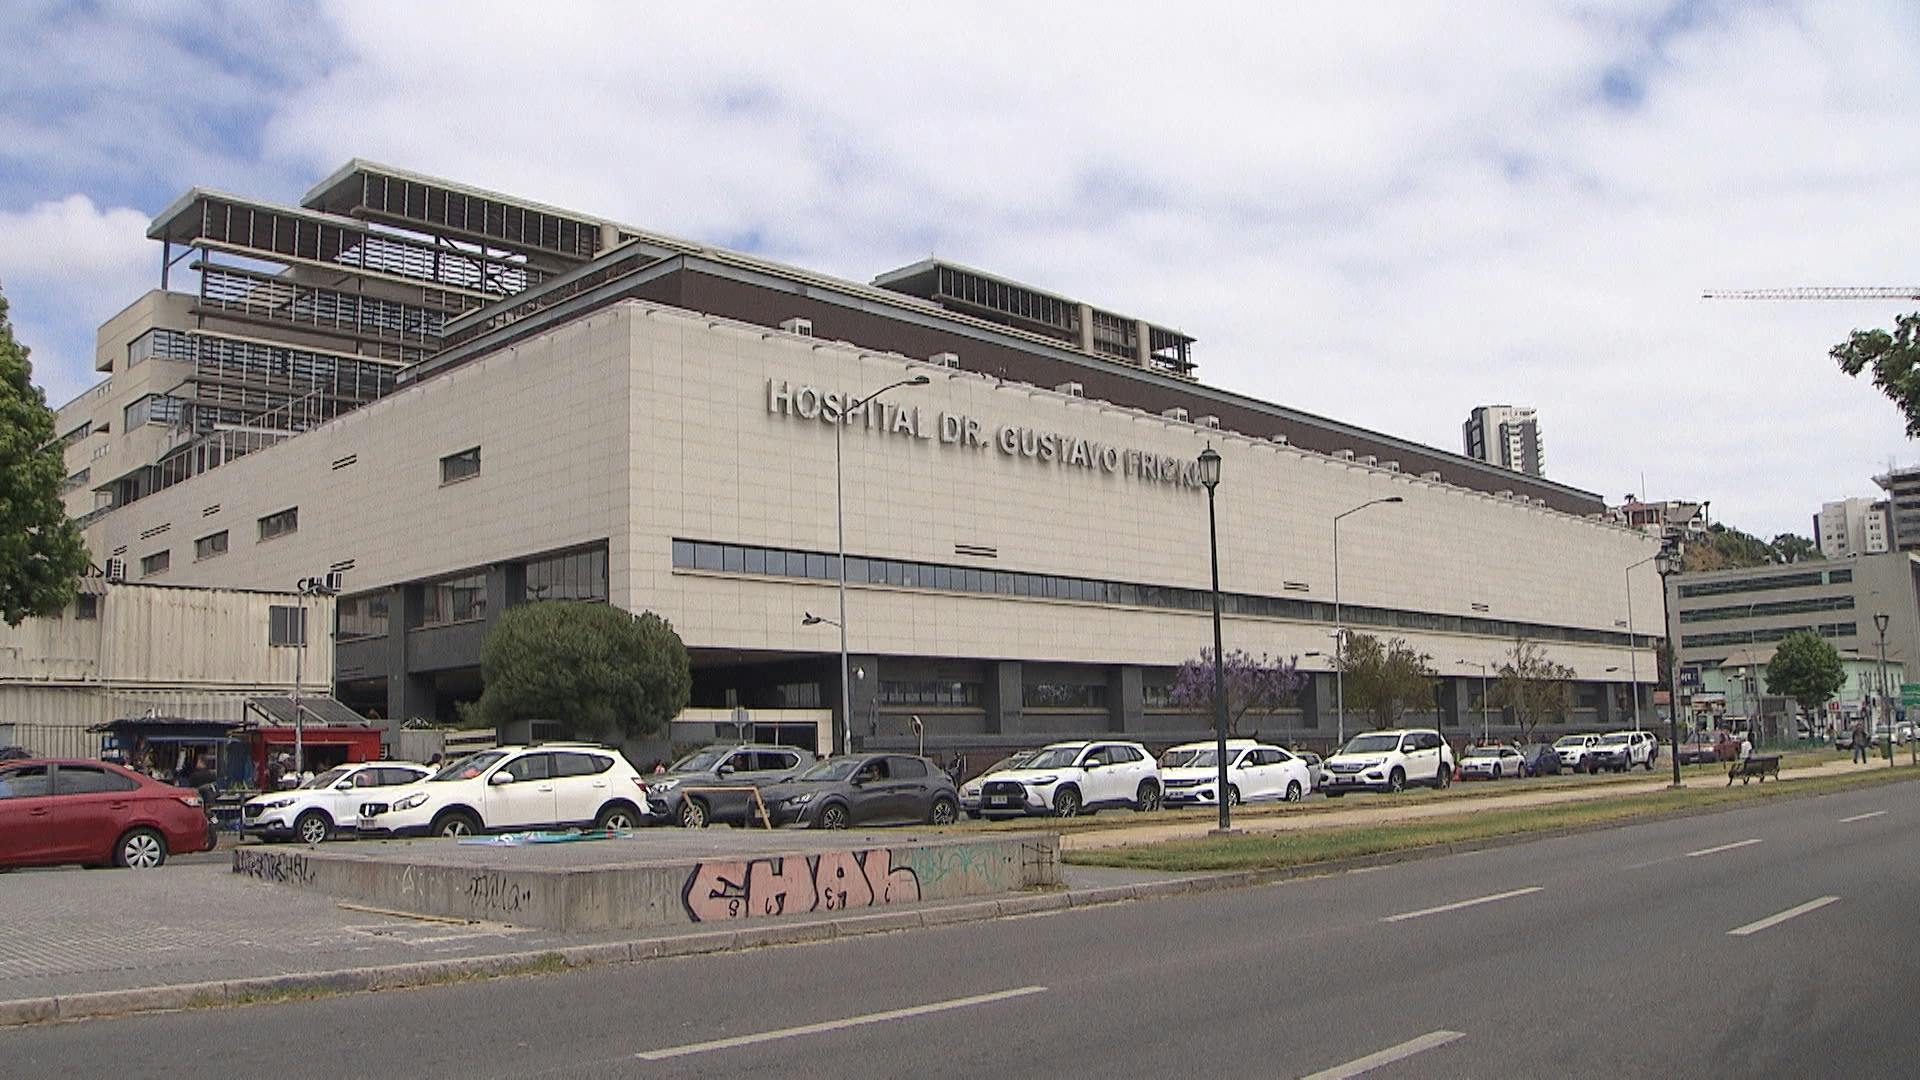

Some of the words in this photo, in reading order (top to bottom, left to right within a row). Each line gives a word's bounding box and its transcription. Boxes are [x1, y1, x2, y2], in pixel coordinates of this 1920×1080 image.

[767, 378, 933, 439] HOSPITAL
[939, 410, 989, 449] DR.
[996, 424, 1119, 473] GUSTAVO
